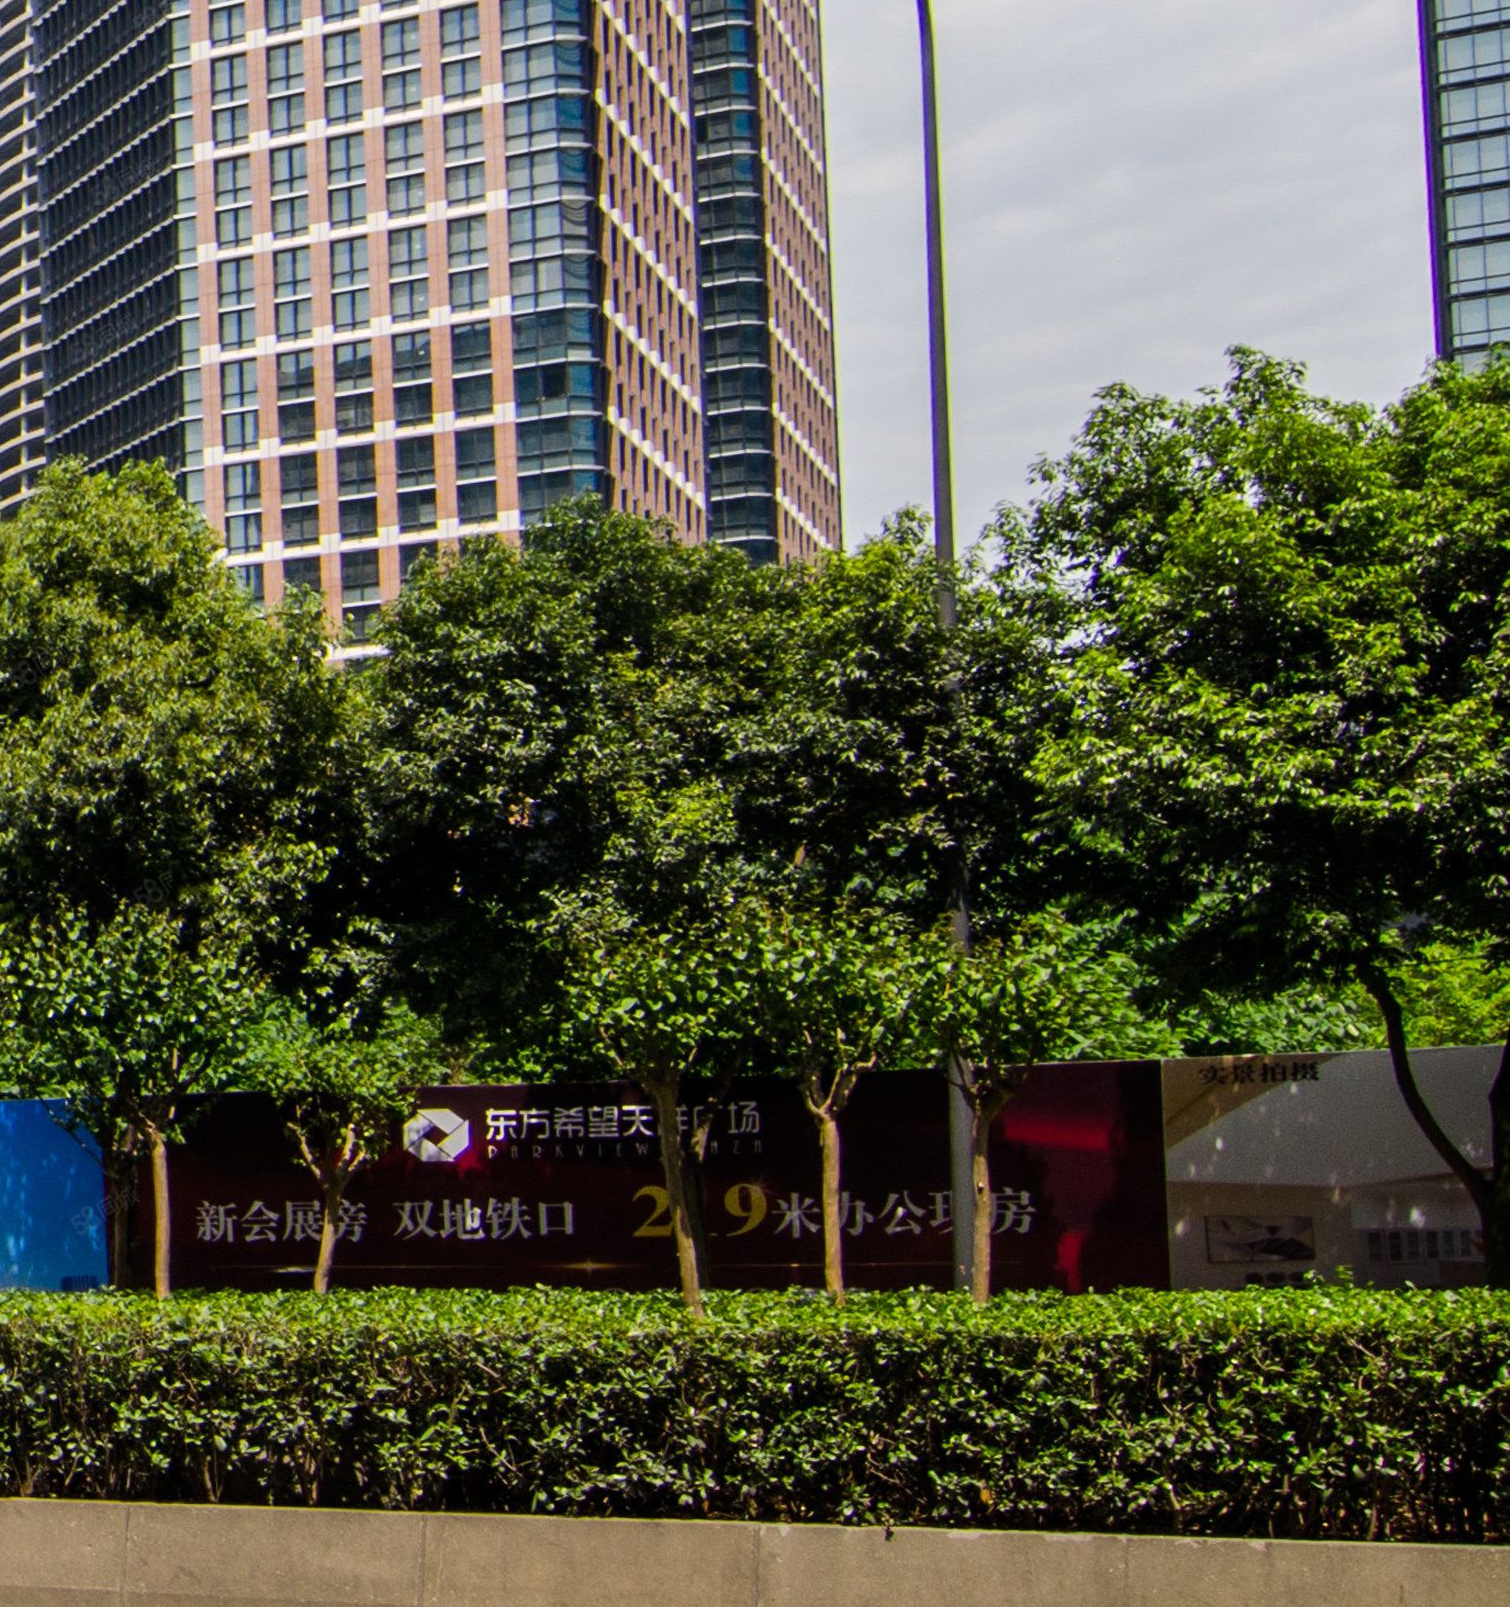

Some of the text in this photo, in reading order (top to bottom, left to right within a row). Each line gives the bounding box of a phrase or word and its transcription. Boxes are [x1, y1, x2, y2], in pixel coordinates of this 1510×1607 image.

[195, 1198, 371, 1244] 新会展旁
[392, 1197, 575, 1241] 双地铁口
